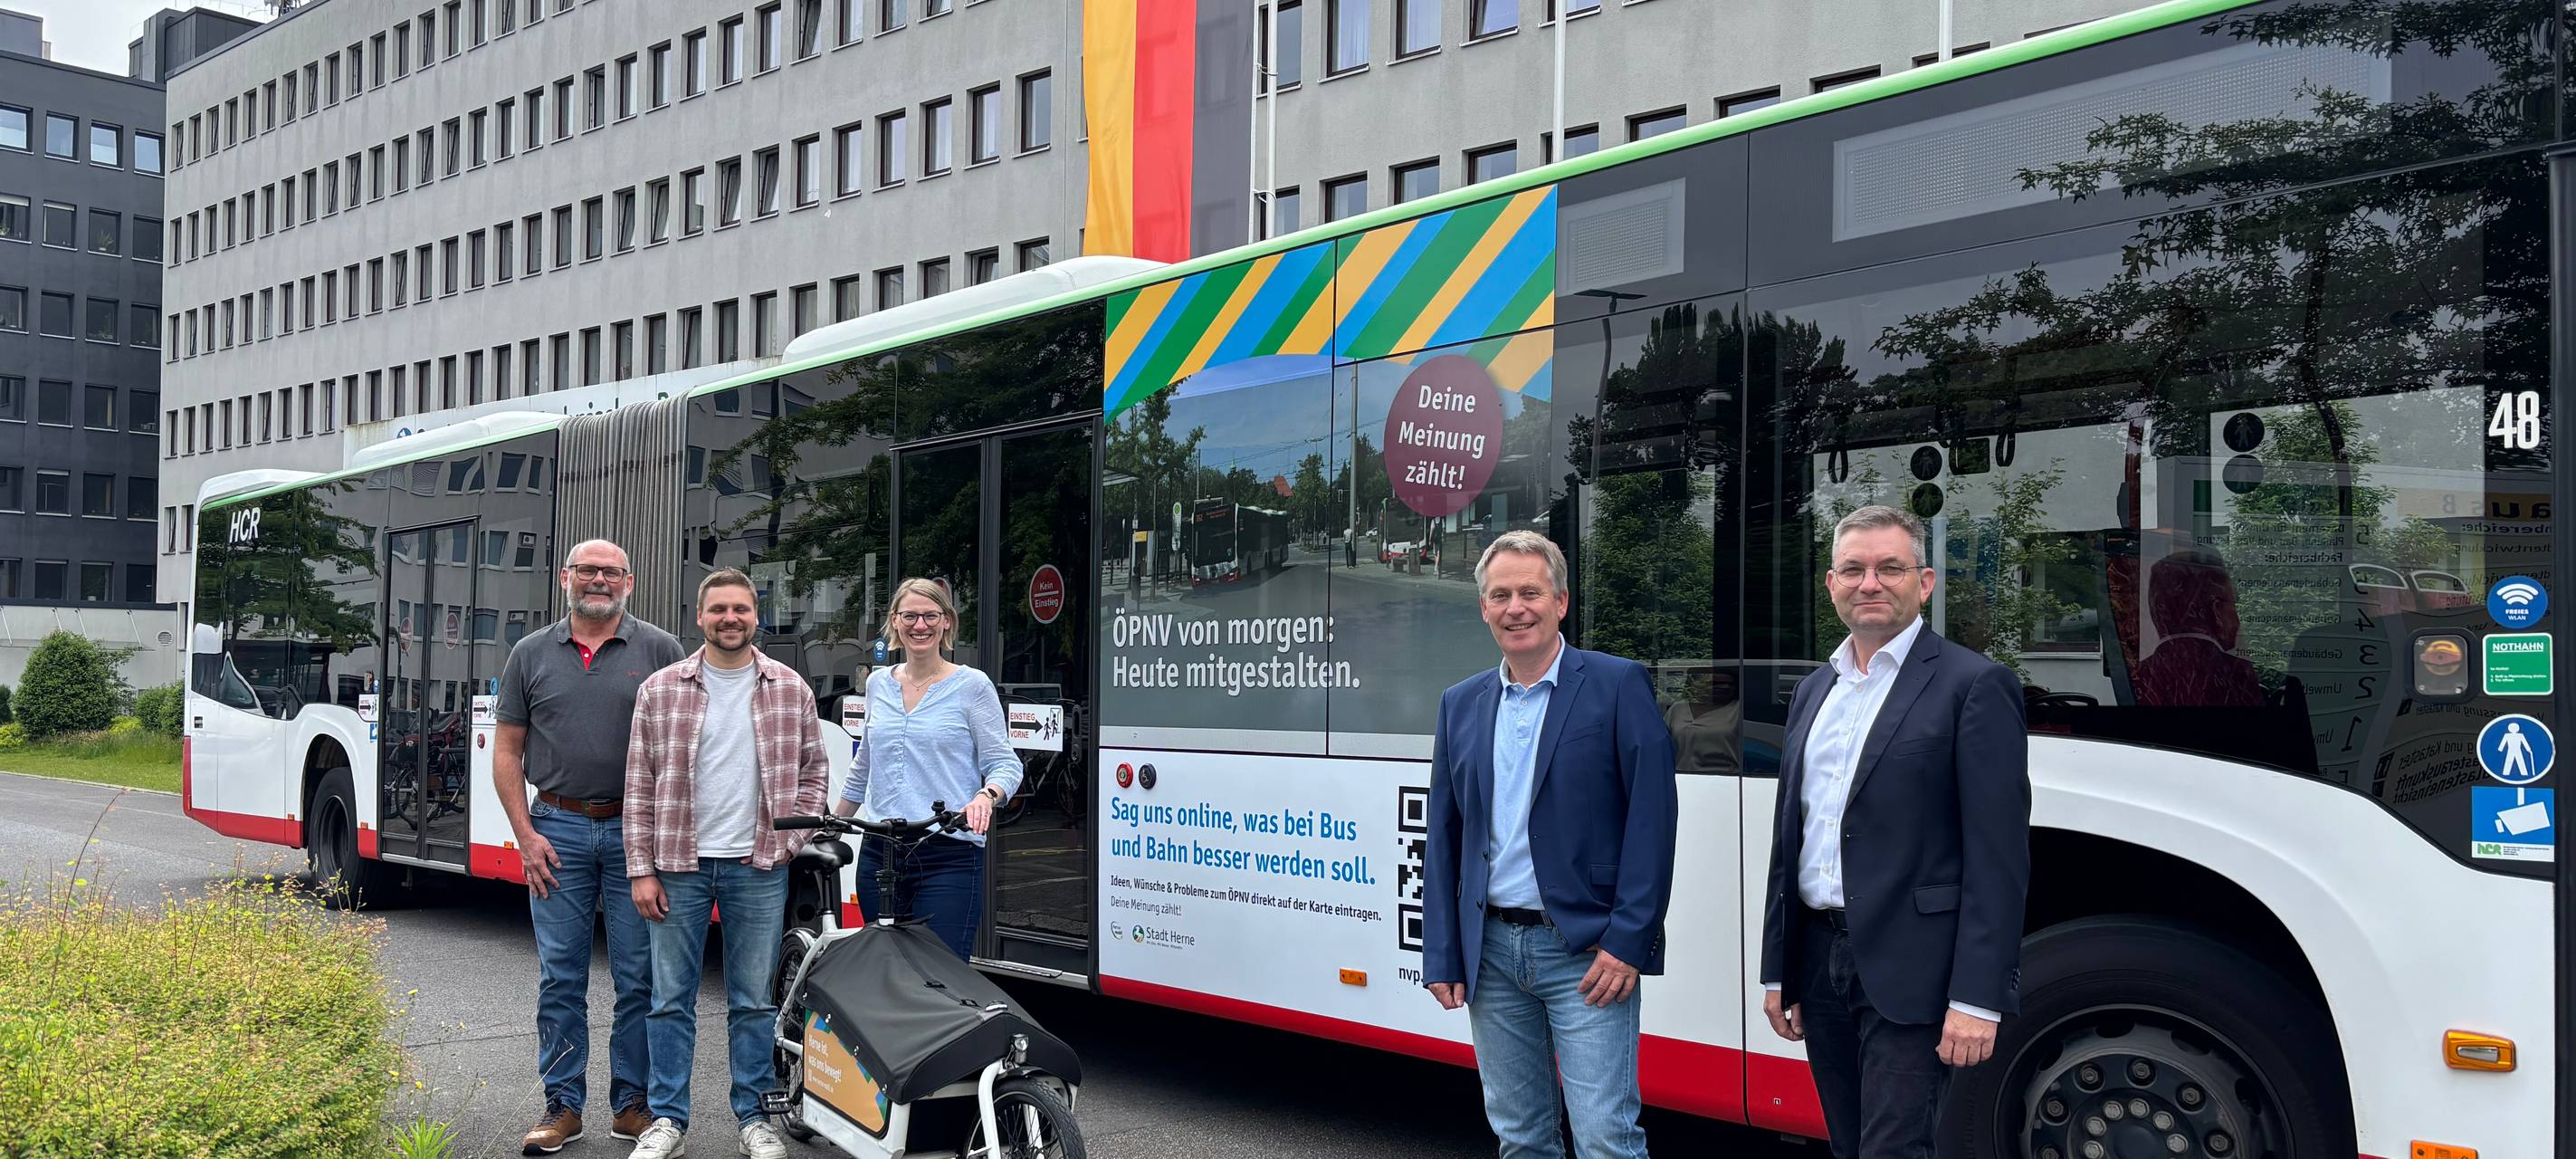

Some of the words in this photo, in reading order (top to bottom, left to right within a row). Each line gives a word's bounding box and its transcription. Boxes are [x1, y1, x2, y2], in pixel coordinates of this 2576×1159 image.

[1418, 385, 1476, 414] Deine
[2488, 390, 2540, 449] 48
[1398, 420, 1485, 460] Meinung
[1405, 460, 1465, 490] zählt!
[229, 506, 261, 543] HCR
[1040, 581, 1054, 590] Kein
[1035, 598, 1058, 608] Einstieg
[1112, 607, 1173, 647] ÖPNV
[1178, 619, 1219, 647] von
[1227, 615, 1334, 653] morgen:
[2492, 642, 2544, 652] NOTHAHN
[1112, 656, 1178, 687] Heute
[1186, 651, 1360, 696] mitgestalten.
[1010, 713, 1035, 721] EINSTIEG
[1111, 797, 1139, 827] Sag
[1144, 804, 1173, 825] uns
[1178, 803, 1237, 834] online,
[1244, 812, 1278, 834] was
[1284, 809, 1312, 838] bei
[1321, 812, 1357, 841] Bus
[1111, 835, 1140, 858] und
[1146, 838, 1188, 863] Bahn
[1193, 842, 1251, 871] besser
[1255, 850, 1325, 879] werden
[1331, 855, 1376, 886] soll.
[1111, 876, 1132, 890] Ideen,
[1133, 877, 1165, 894] Wünsche
[1167, 882, 1173, 894] &
[1174, 882, 1208, 898] Probleme
[1210, 890, 1226, 900] zum
[1228, 886, 1249, 904] ÖPNV
[1251, 891, 1275, 907] direkt
[1277, 895, 1292, 909] auf
[1293, 897, 1307, 911] der
[1309, 899, 1332, 915] Karte
[1335, 902, 1382, 922] eintragen.
[1111, 896, 1129, 910] Deine
[1131, 898, 1159, 916] Meinung
[1161, 901, 1181, 916] zählt!
[1146, 927, 1169, 942] Stadt
[1170, 931, 1195, 945] Herne
